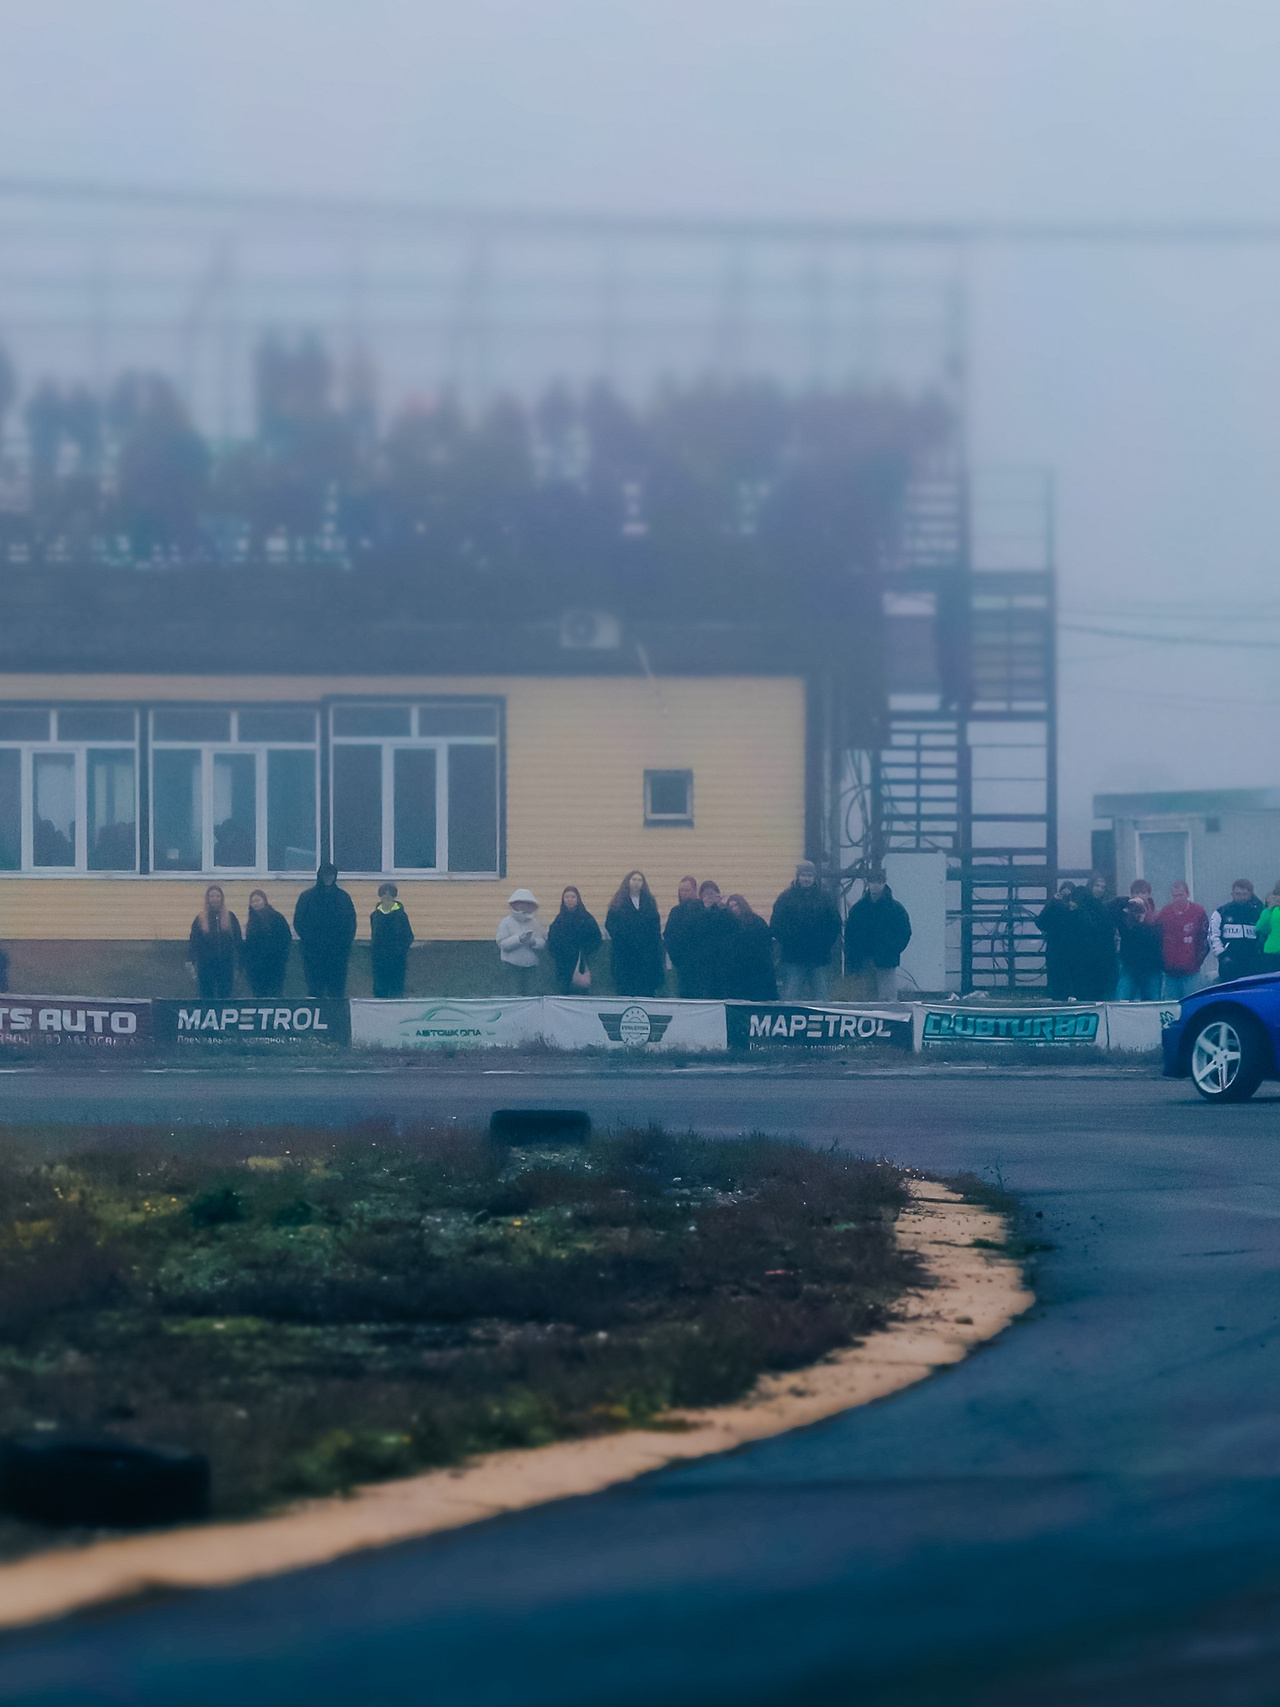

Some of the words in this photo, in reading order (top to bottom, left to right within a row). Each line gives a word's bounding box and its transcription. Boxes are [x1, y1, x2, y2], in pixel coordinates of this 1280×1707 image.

[38, 1008, 137, 1034] AUTO
[177, 1007, 328, 1031] MAPETROL
[749, 1014, 892, 1038] MAPETROL
[925, 1014, 1097, 1038] CLUBTURBO
